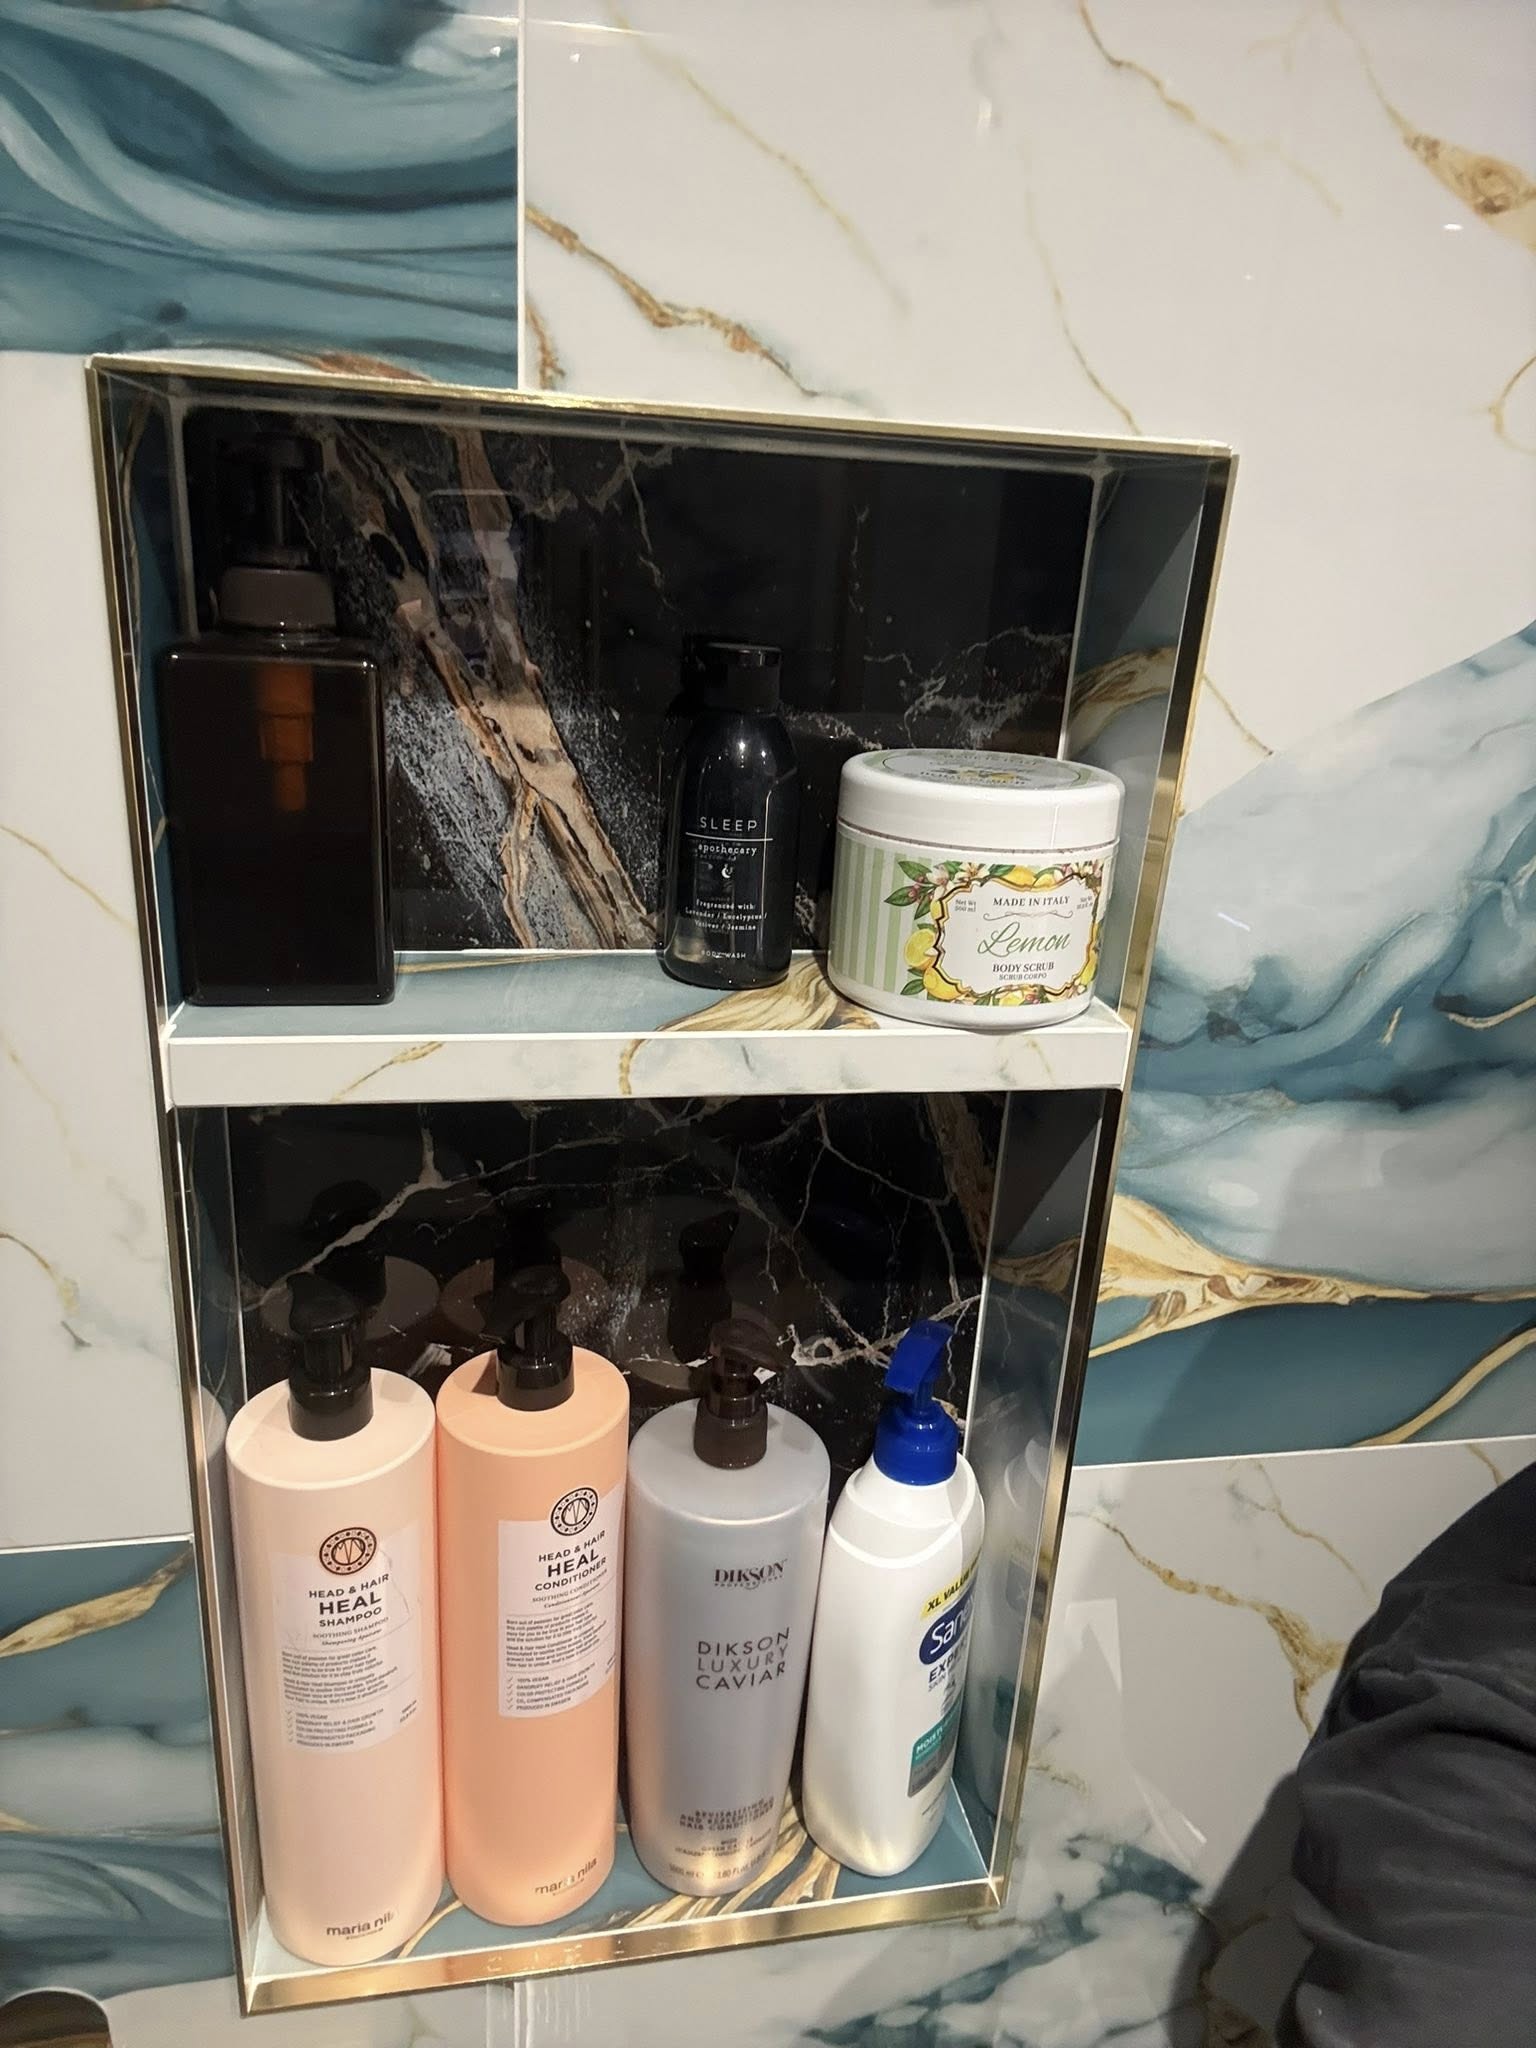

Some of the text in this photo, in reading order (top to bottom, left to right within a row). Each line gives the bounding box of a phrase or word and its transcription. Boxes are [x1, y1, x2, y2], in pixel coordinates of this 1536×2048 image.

[700, 816, 758, 831] SLEEP
[698, 843, 757, 857] apothecary
[993, 897, 1026, 907] MADE
[1029, 897, 1041, 906] IN
[1042, 896, 1070, 906] ITALY
[727, 923, 756, 931] Jasmine
[977, 921, 1071, 957] Lemon
[992, 962, 1055, 973] BODY SCRUB
[999, 972, 1047, 981] SCRUB CORPO
[538, 1530, 605, 1562] HEAD & HAIR
[535, 1557, 606, 1591] CONDITIONER
[548, 1549, 599, 1578] HEAL
[714, 1561, 784, 1583] DIKSON
[309, 1573, 389, 1599] HEAD & HAIR
[319, 1591, 382, 1615] HEAL
[927, 1597, 941, 1612] XL
[319, 1606, 382, 1628] SHAMPOO
[698, 1626, 789, 1656] DIKSON
[698, 1643, 788, 1673] LUXURY
[696, 1660, 785, 1690] CAVIAR
[577, 1858, 597, 1879] nila
[326, 1922, 371, 1936] maria
